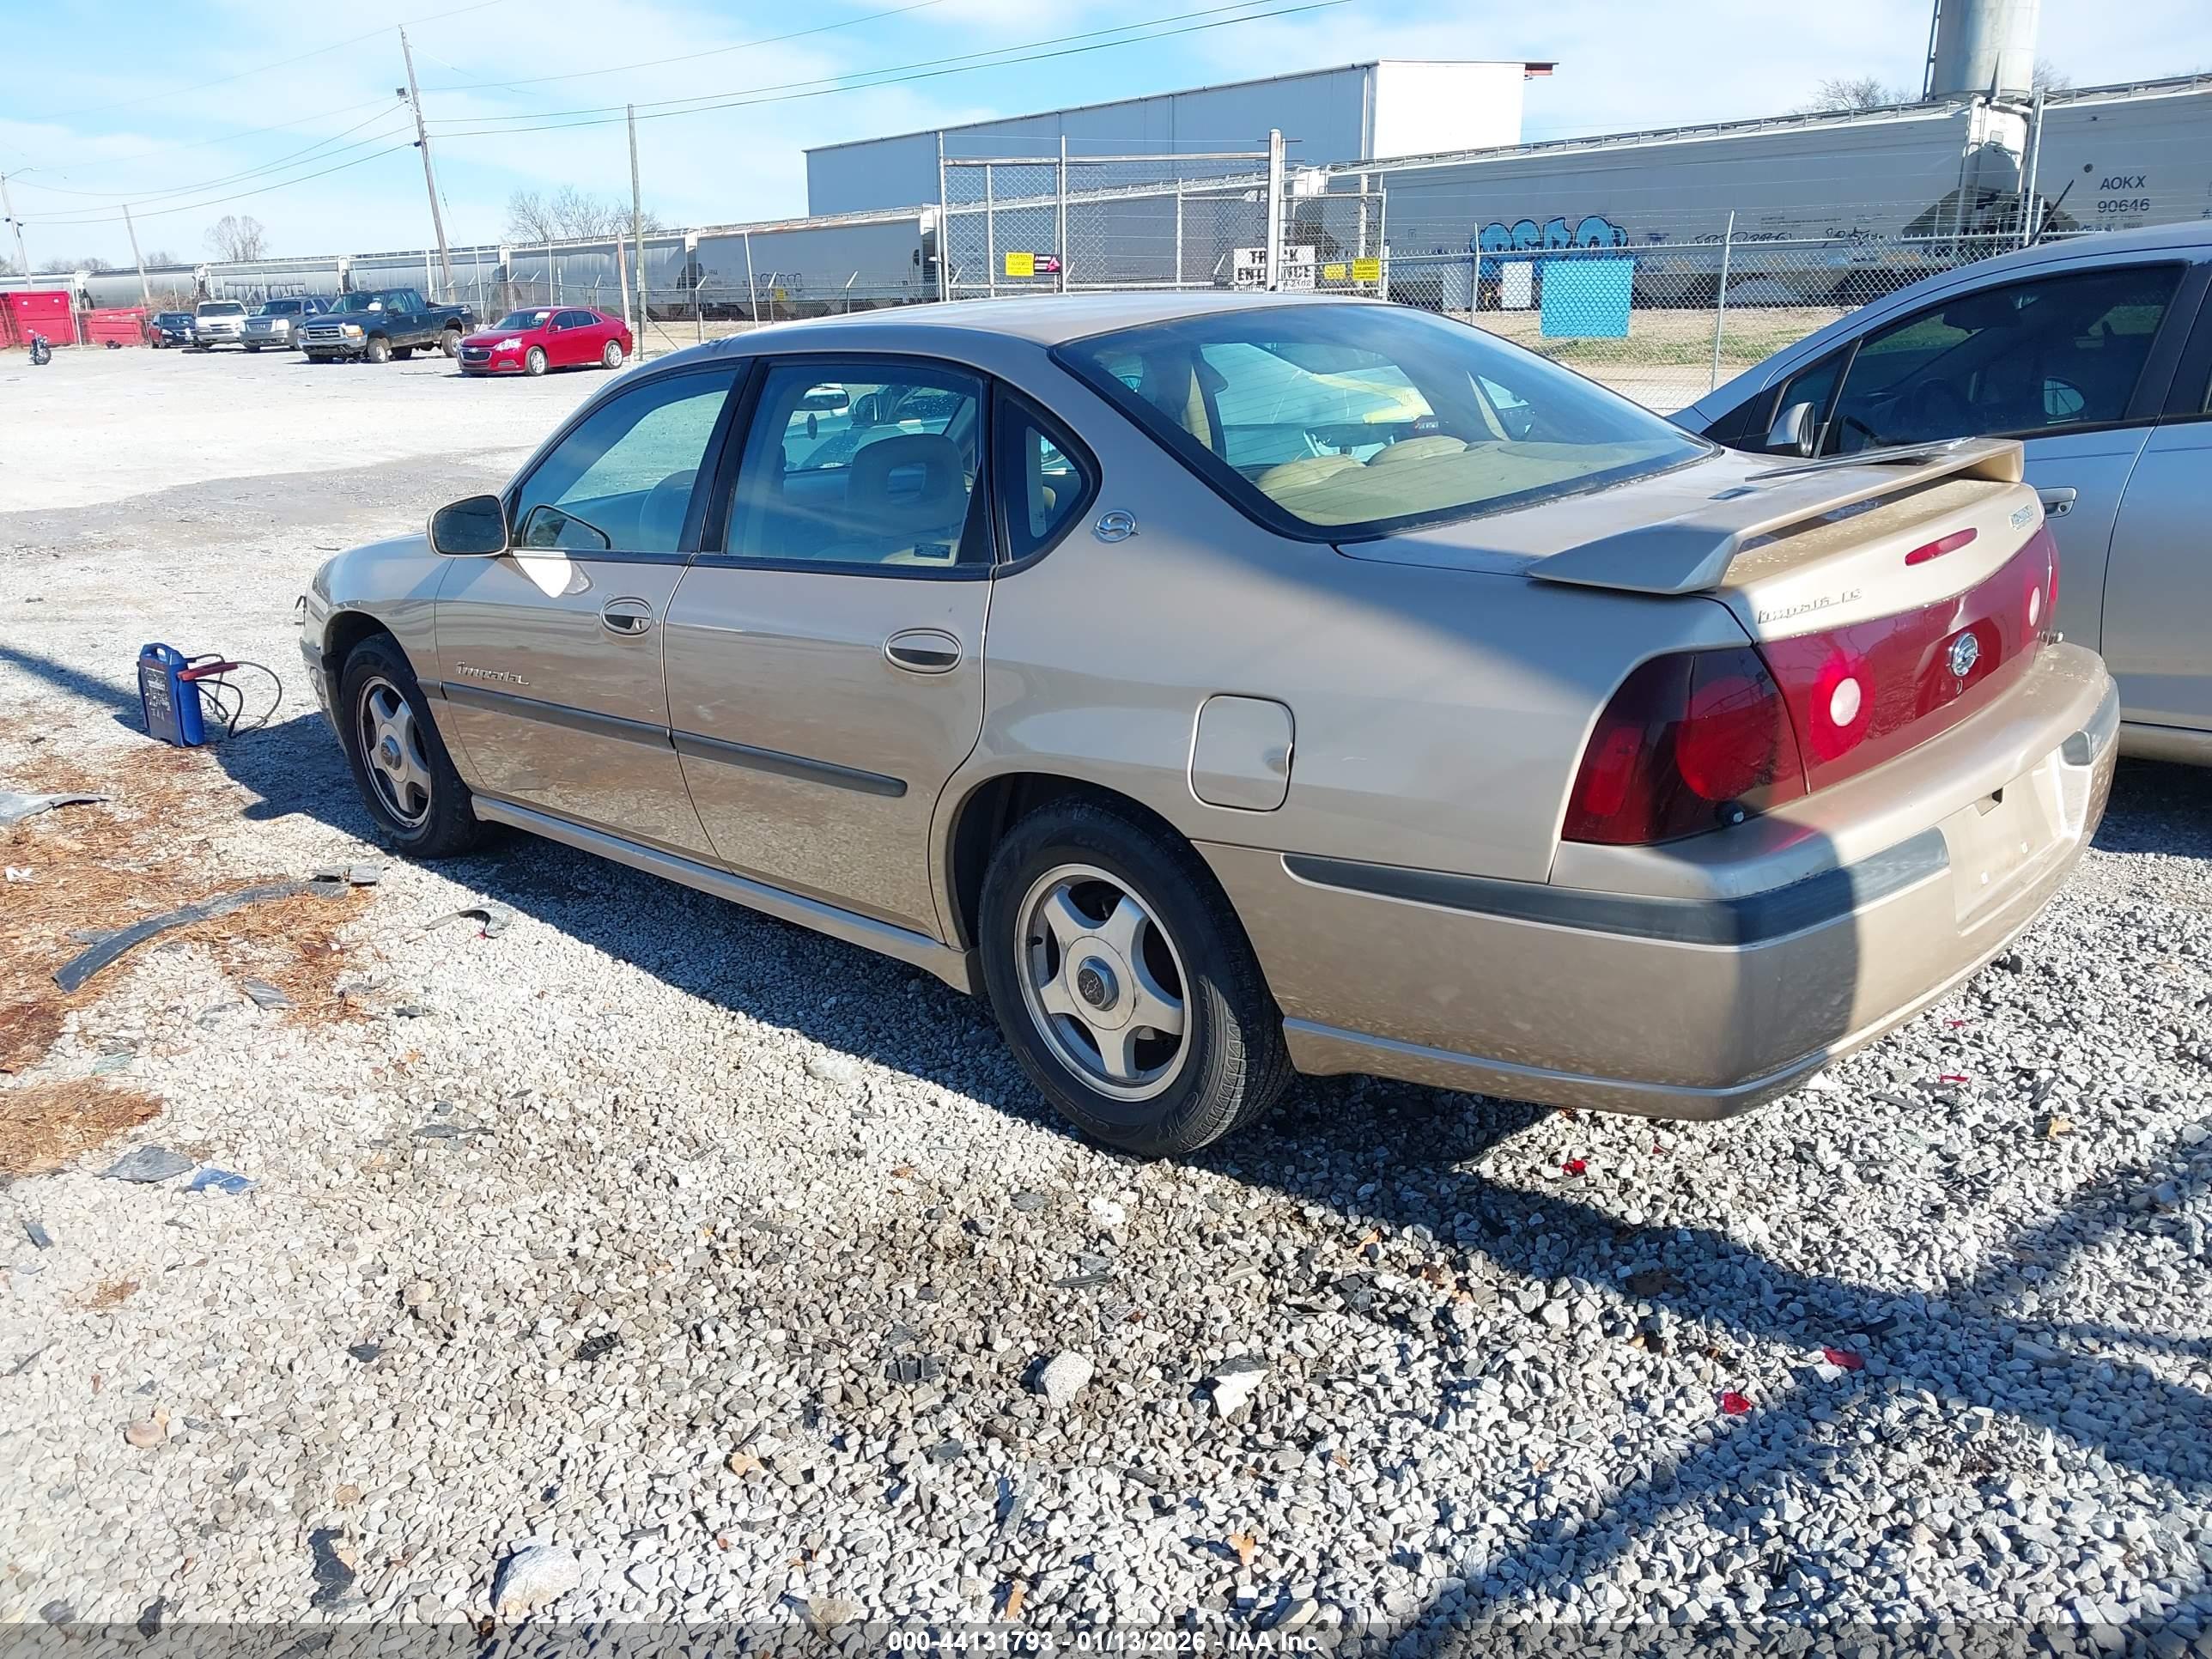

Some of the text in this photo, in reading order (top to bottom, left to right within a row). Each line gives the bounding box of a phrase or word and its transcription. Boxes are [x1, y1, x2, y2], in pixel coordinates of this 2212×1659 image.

[2100, 175, 2147, 191] AOKX
[2097, 198, 2150, 214] 90646
[1249, 249, 1298, 264] TRK
[1237, 266, 1310, 281] ENTNCE
